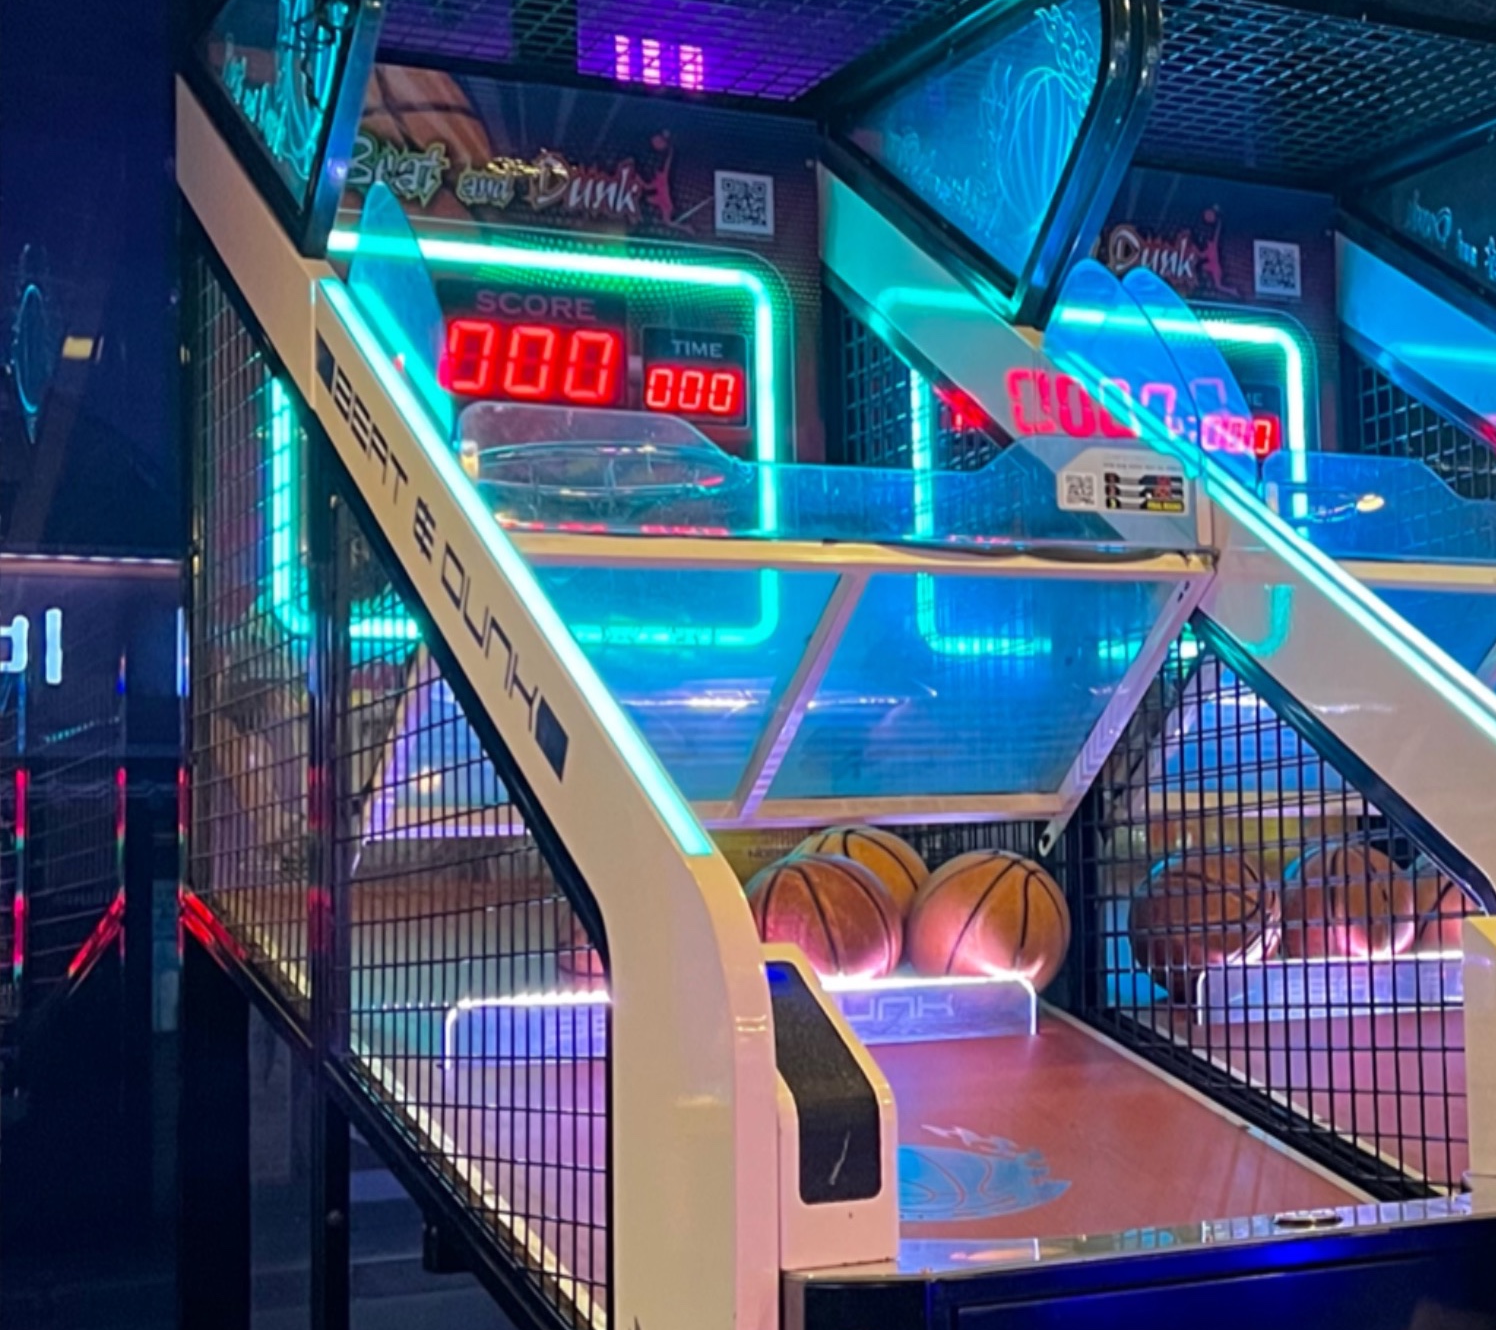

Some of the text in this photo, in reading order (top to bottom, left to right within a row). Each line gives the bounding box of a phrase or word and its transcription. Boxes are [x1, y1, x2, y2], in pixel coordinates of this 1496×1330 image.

[475, 289, 597, 321] SCORE
[671, 338, 724, 359] TIME
[645, 367, 735, 414] 000
[332, 362, 410, 505] BEAT
